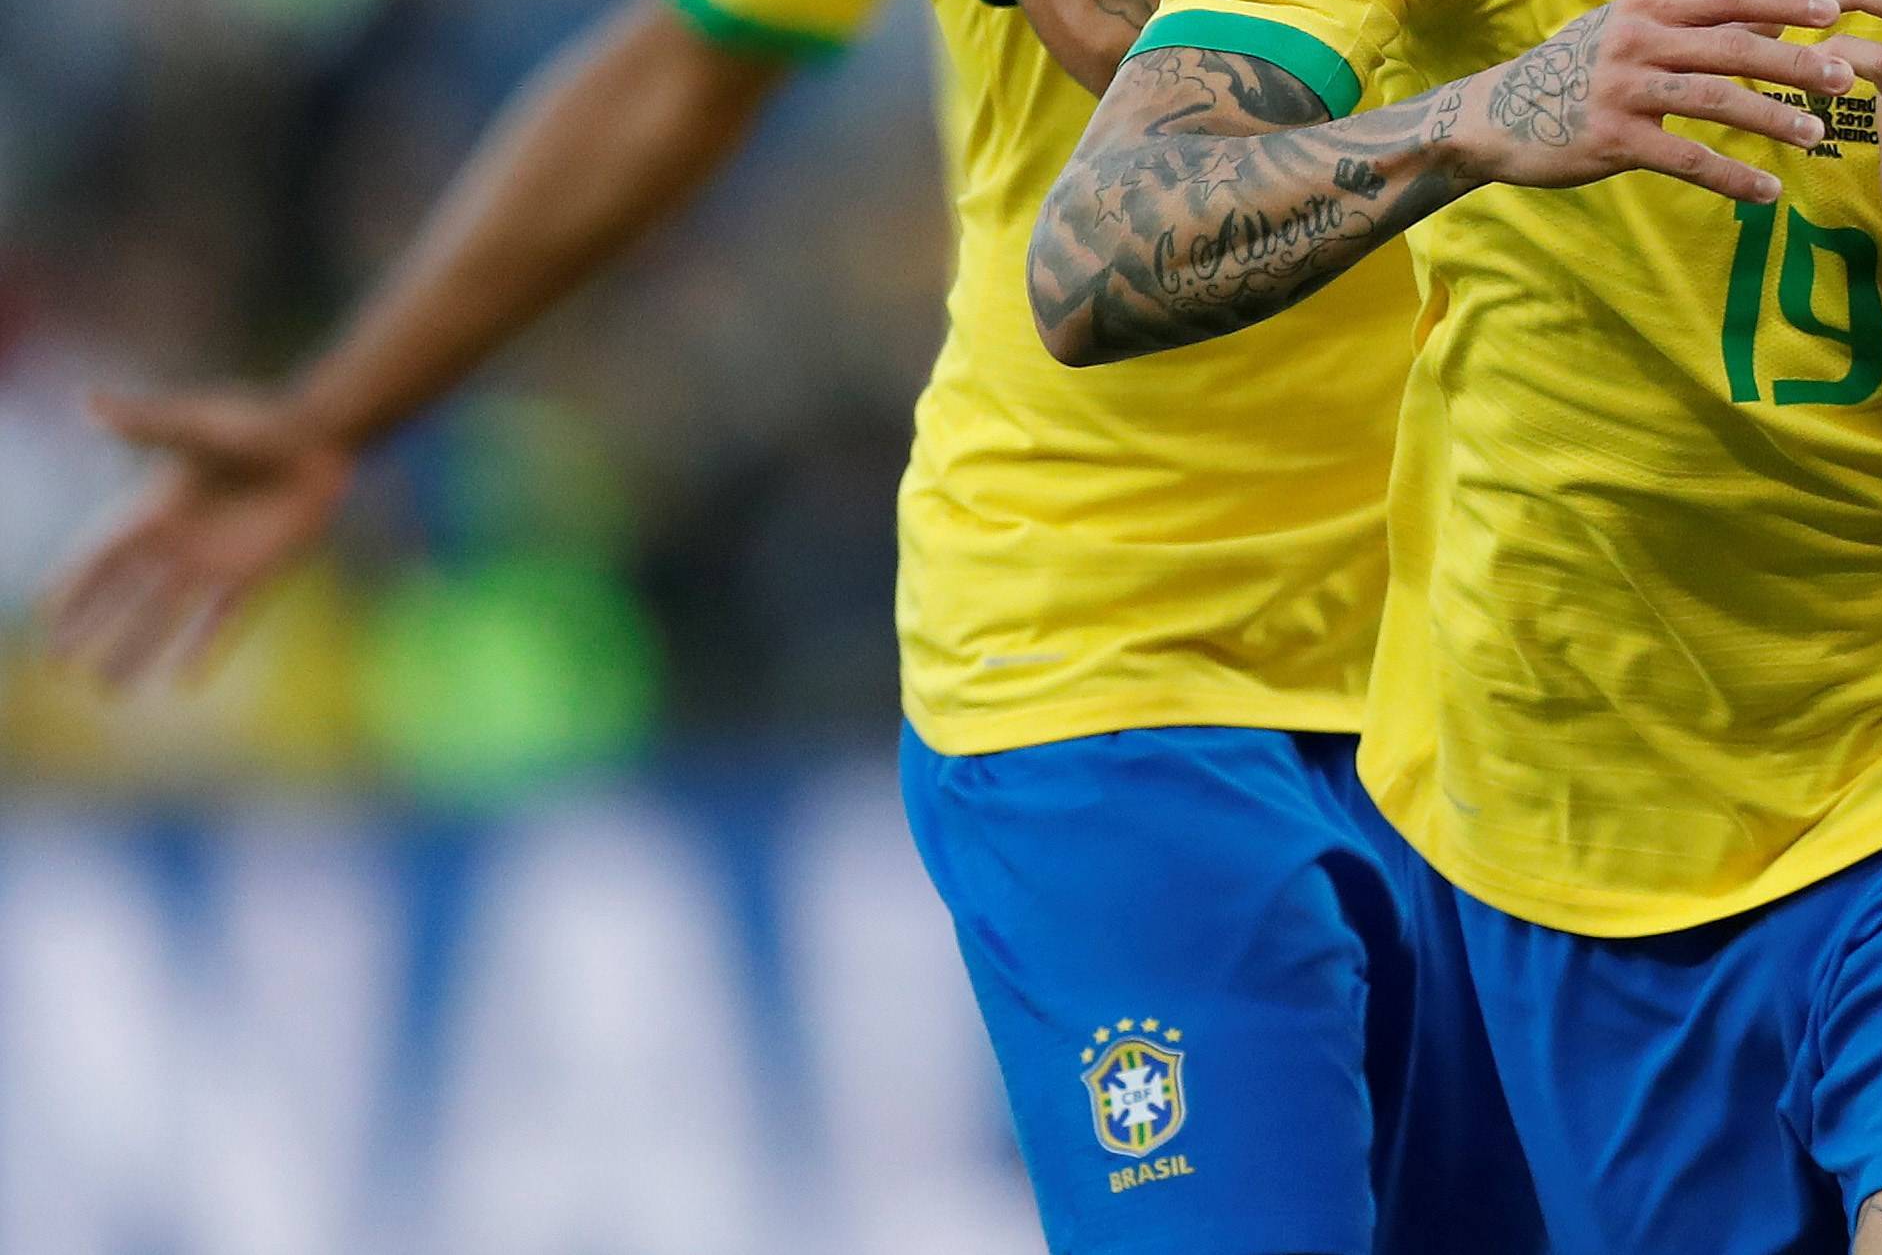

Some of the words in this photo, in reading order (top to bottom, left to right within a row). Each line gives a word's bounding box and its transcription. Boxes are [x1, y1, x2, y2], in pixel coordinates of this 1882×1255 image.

[1836, 111, 1874, 128] 2019
[1122, 1088, 1151, 1107] CBF
[1108, 1154, 1195, 1194] BRASIL
